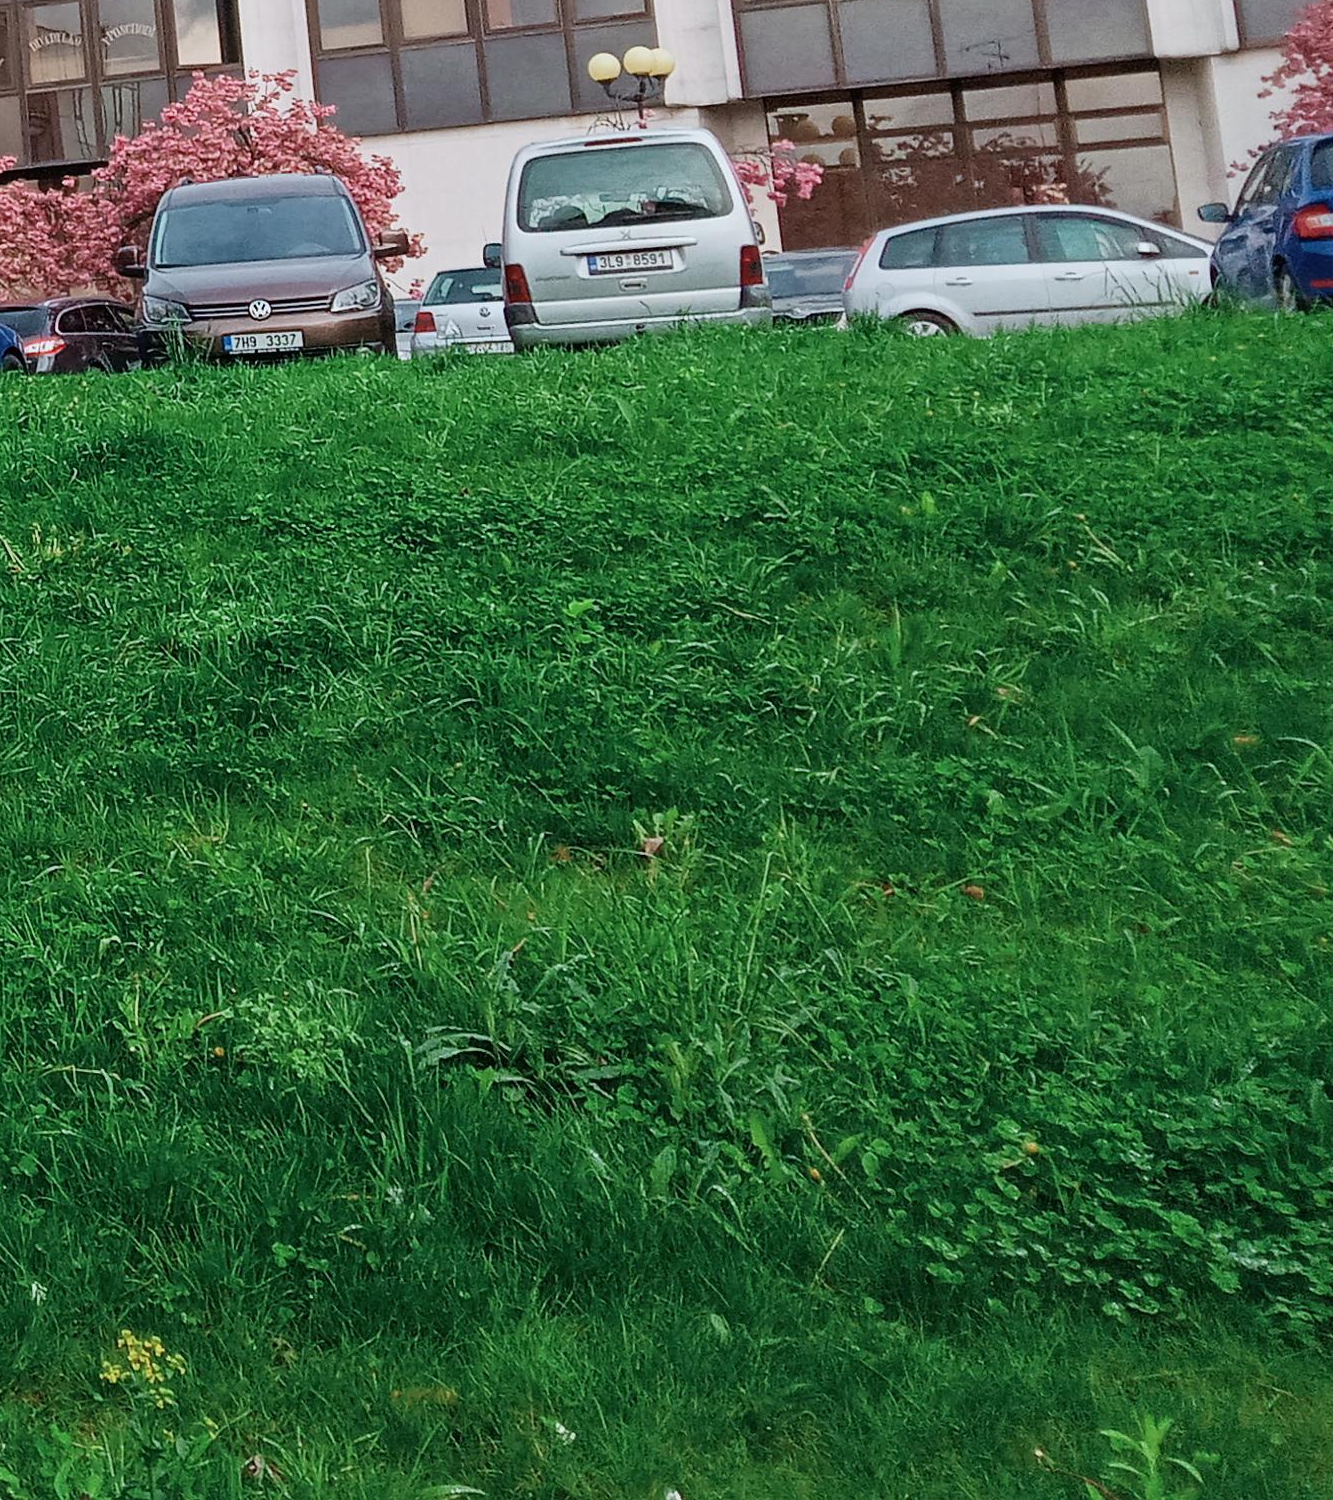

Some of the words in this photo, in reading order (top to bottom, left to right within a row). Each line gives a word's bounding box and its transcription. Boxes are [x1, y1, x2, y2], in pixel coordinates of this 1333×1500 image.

[600, 256, 624, 268] 3L9
[633, 253, 665, 266] 8591
[234, 337, 257, 348] 7H9
[266, 335, 296, 346] 3337
